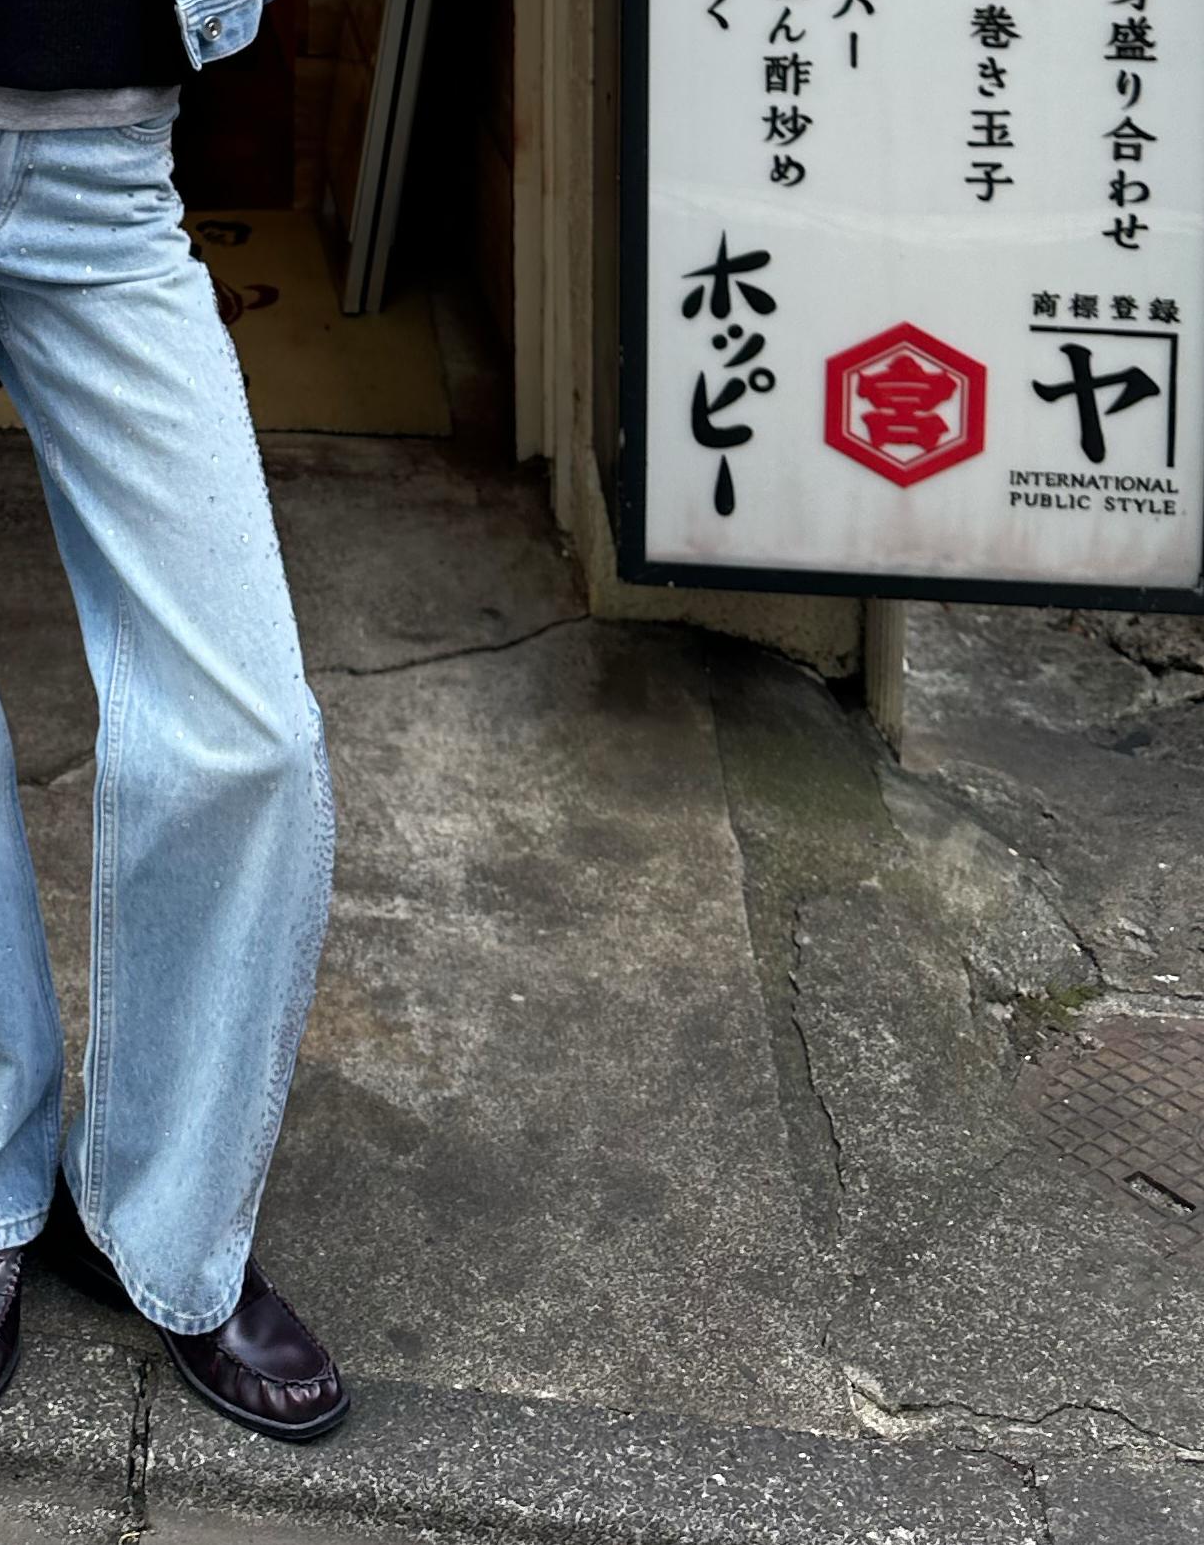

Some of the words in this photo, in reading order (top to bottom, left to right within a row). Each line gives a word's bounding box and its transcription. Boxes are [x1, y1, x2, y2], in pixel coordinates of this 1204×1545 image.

[681, 229, 777, 516] ホッピー
[1009, 469, 1179, 494] INTERNATIONAL
[1010, 490, 1091, 511] PUBLIC
[1104, 495, 1177, 516] STYLE
